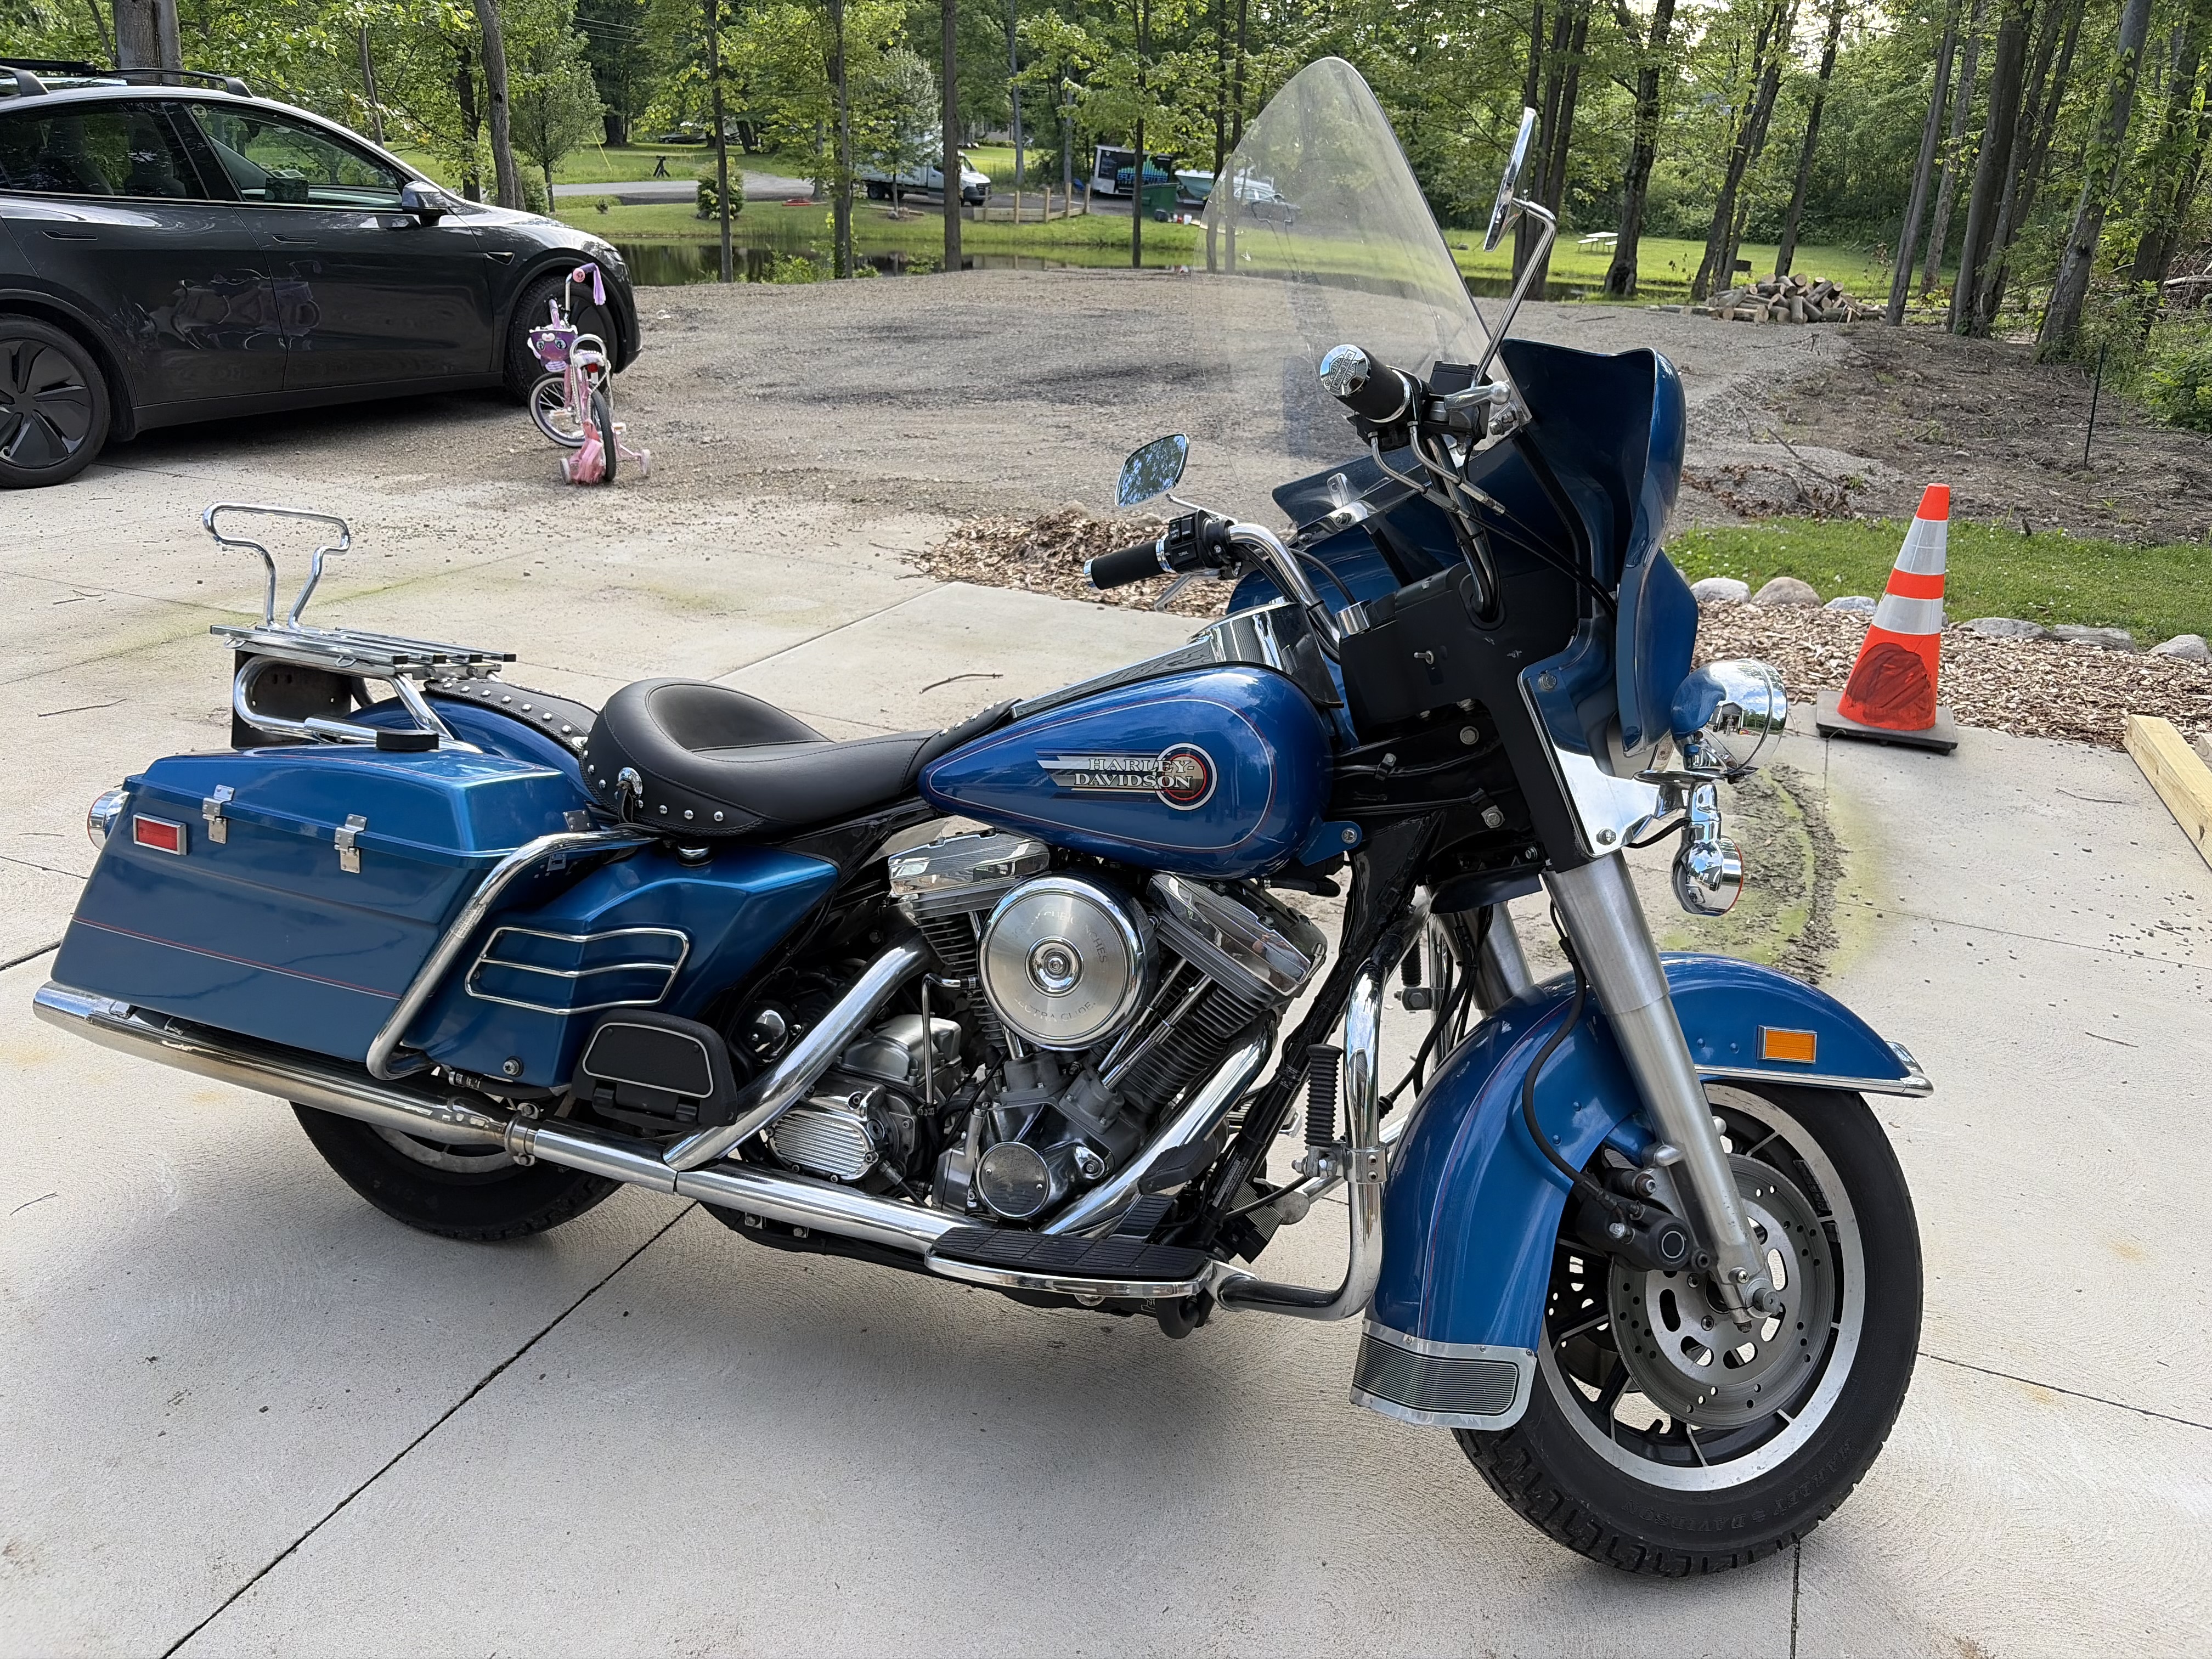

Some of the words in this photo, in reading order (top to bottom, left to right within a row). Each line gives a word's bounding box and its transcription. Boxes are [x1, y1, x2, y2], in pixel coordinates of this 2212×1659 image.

[1089, 759, 1195, 773] HARLEY-
[1074, 773, 1193, 788] DAVIDSON
[1621, 1499, 1746, 1531] DAVIDSON
